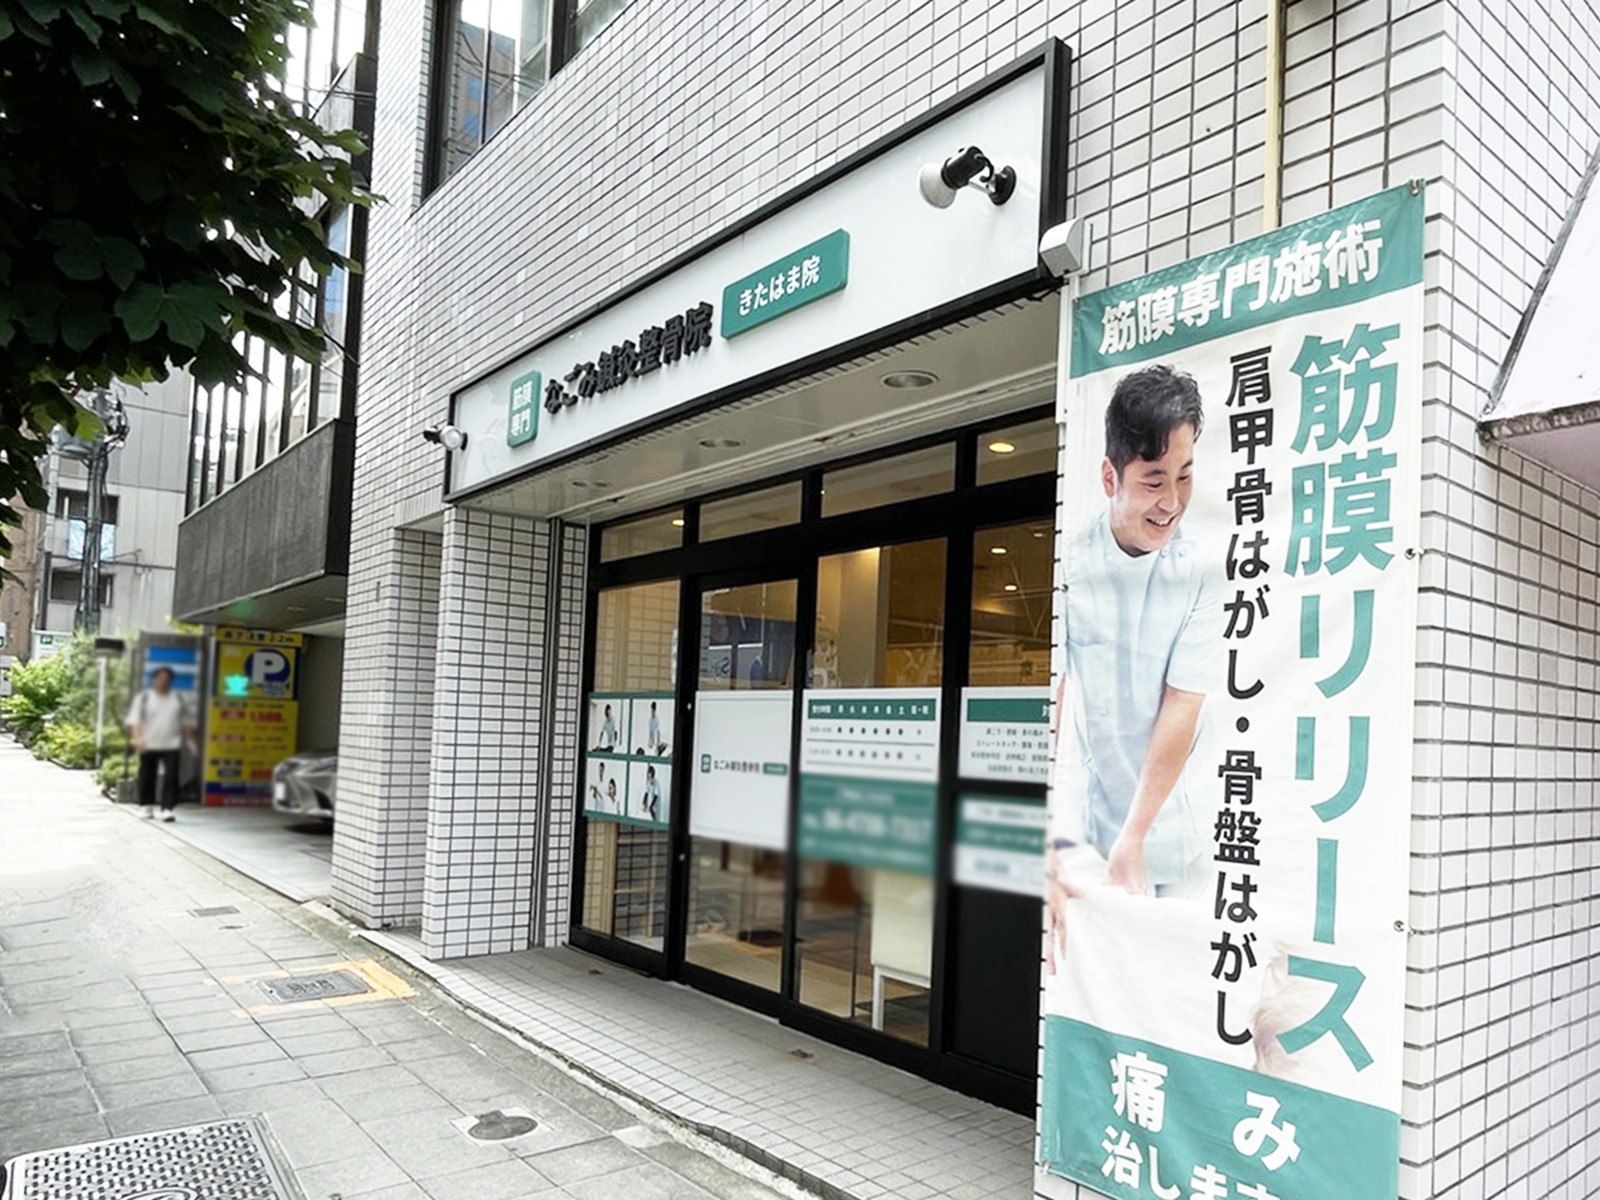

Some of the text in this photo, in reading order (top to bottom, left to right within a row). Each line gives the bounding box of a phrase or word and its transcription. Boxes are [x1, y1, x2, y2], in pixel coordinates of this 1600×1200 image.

[738, 256, 821, 316] きたはま院
[1098, 220, 1383, 356] 筋膜専門施術
[252, 651, 285, 684] P
[1210, 345, 1273, 1045] 肩甲骨はがし・骨盤はがし
[1275, 322, 1401, 1072] 筋膜リリース
